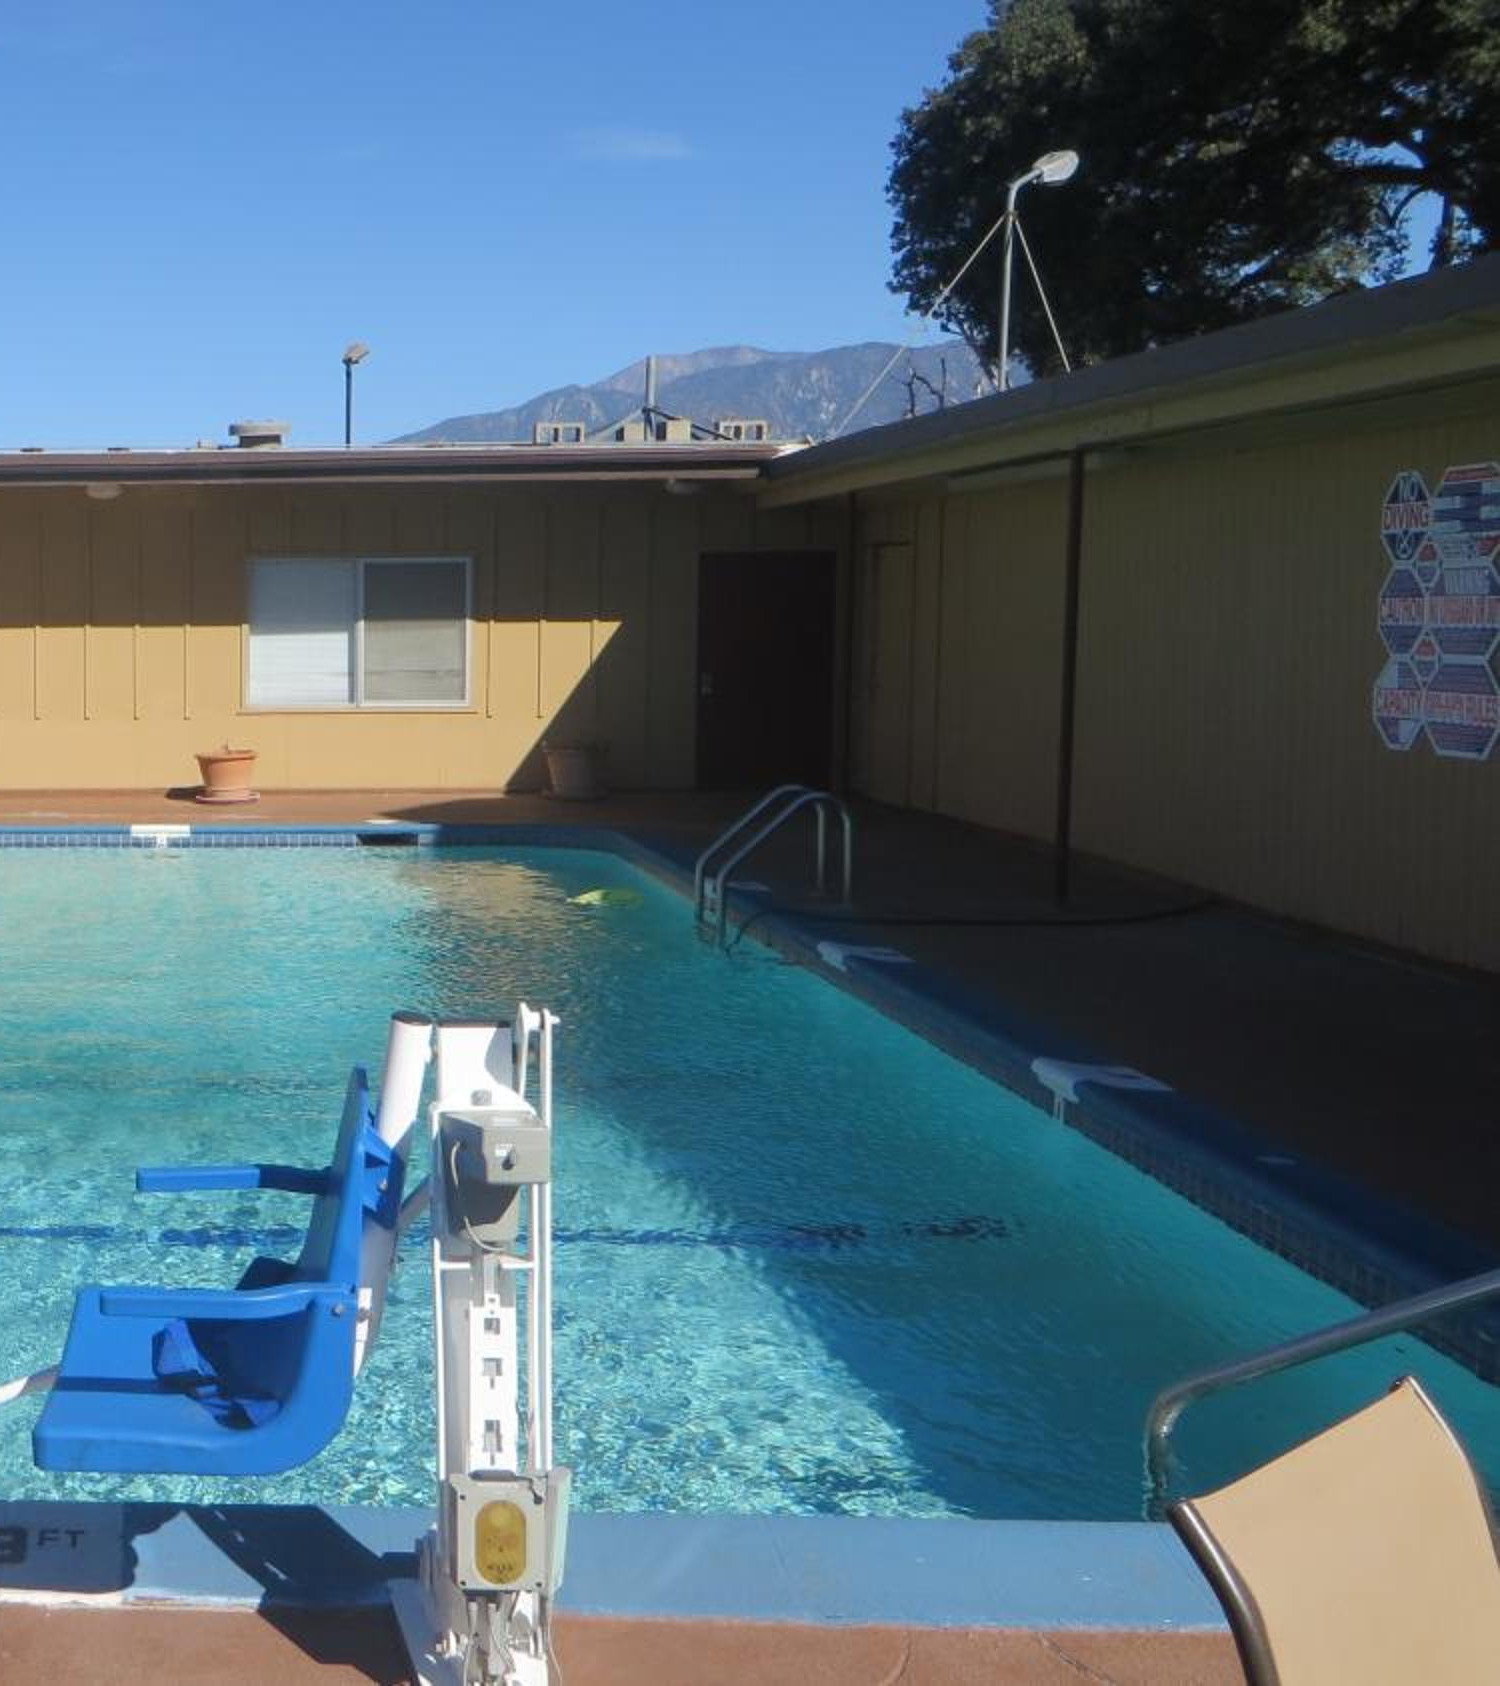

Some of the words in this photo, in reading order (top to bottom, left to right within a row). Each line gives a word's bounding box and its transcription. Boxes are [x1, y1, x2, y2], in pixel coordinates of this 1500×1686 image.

[1399, 478, 1418, 501] NO
[1381, 506, 1429, 530] DIVING
[38, 1529, 85, 1549] FT
